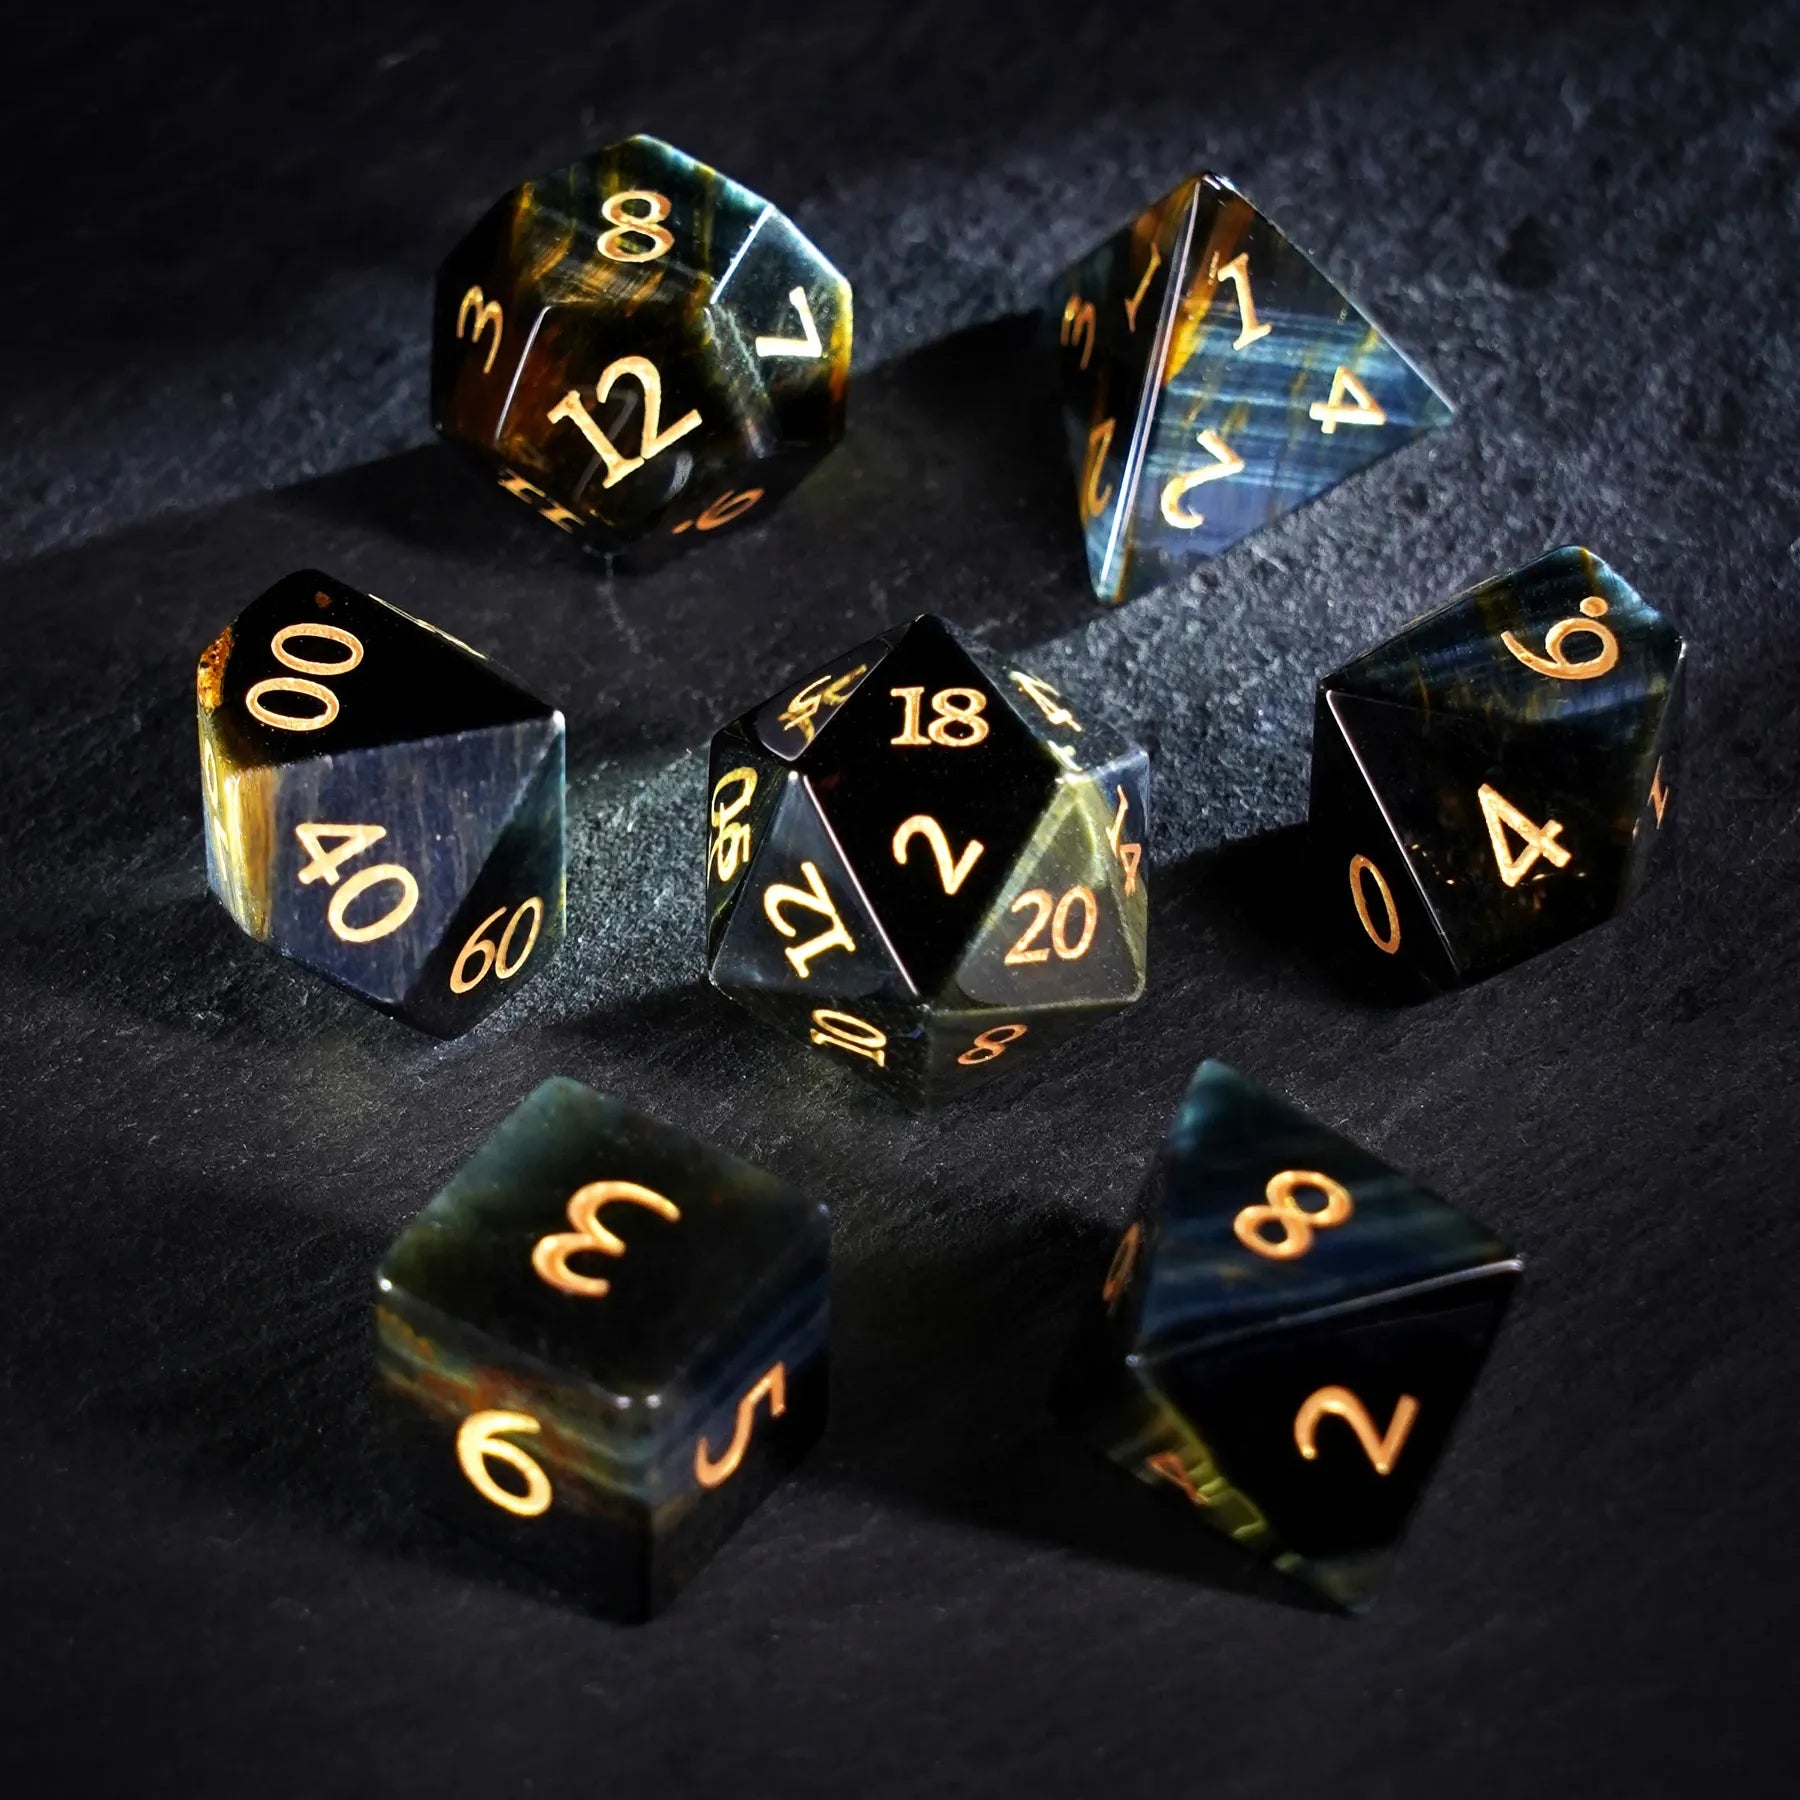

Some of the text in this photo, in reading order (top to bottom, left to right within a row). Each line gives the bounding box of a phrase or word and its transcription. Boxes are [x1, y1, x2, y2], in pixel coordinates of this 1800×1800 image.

[596, 188, 675, 263] 8
[457, 285, 503, 374] 3
[754, 285, 829, 361] 7
[1060, 294, 1097, 371] 3
[1124, 242, 1162, 334] 1
[1215, 250, 1273, 353] 1
[546, 355, 703, 489] 12
[1308, 363, 1388, 435] 4
[1159, 427, 1247, 530] 2
[245, 622, 365, 732] 00
[889, 686, 990, 748] 18
[891, 814, 985, 896] 2
[1477, 783, 1572, 888] 4
[294, 821, 420, 944] 40
[763, 860, 856, 979] 12
[1001, 883, 1099, 967] 20
[1349, 854, 1401, 955] 0
[449, 896, 544, 994] 60
[809, 1008, 887, 1068] 10
[957, 1024, 1027, 1065] 8
[531, 1180, 680, 1297] 3
[1233, 1170, 1352, 1260] 8
[456, 1404, 553, 1517] 6
[1294, 1386, 1417, 1475] 2
